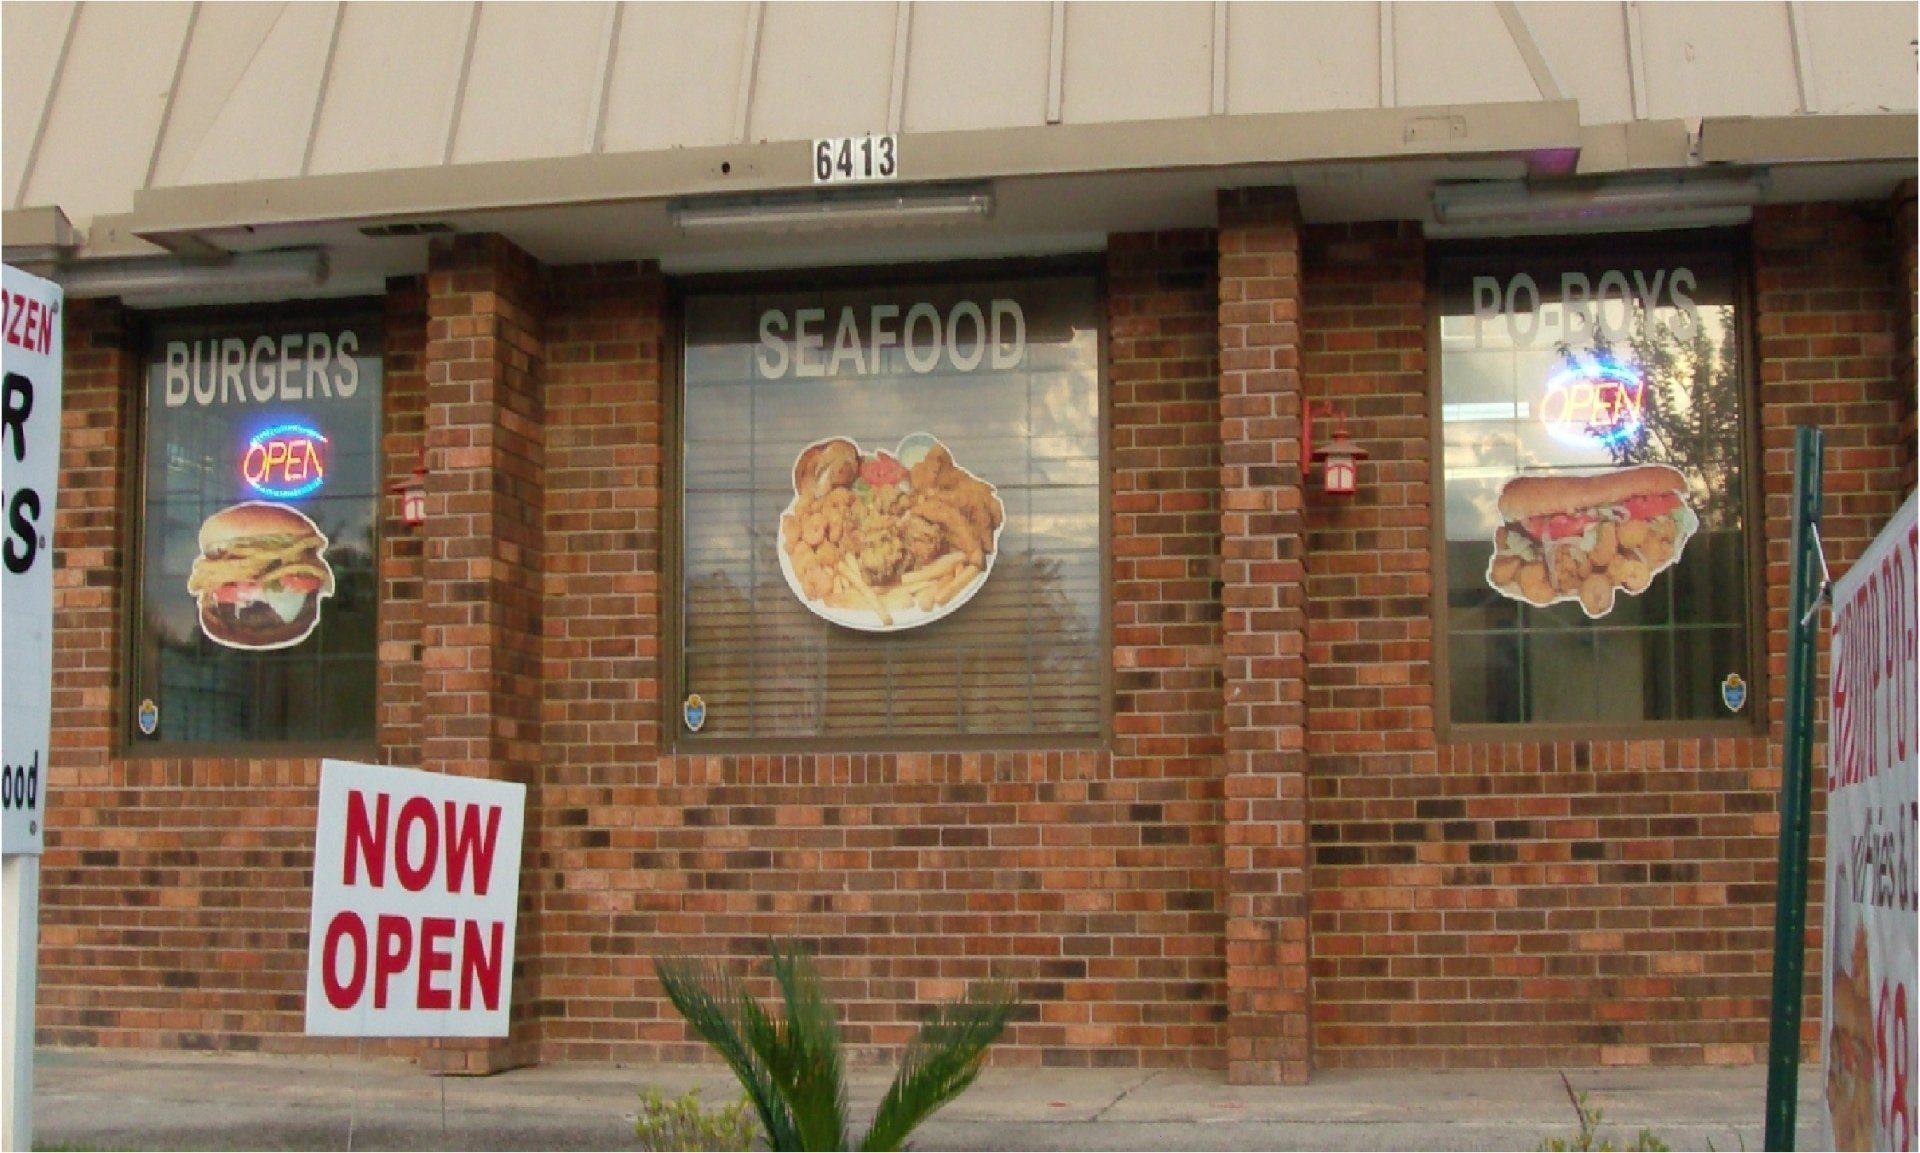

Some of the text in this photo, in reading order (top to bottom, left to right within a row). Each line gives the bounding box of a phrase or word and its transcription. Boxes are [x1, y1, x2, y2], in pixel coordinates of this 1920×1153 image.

[815, 136, 896, 180] 6413
[756, 299, 1027, 379] SEAFOOD
[1472, 266, 1698, 348] PO-BOYS
[165, 329, 359, 407] BURGERS
[1539, 379, 1644, 428] OPEN
[243, 439, 324, 483] OPEN
[342, 790, 502, 896] NOW
[322, 910, 505, 1011] OPEN
